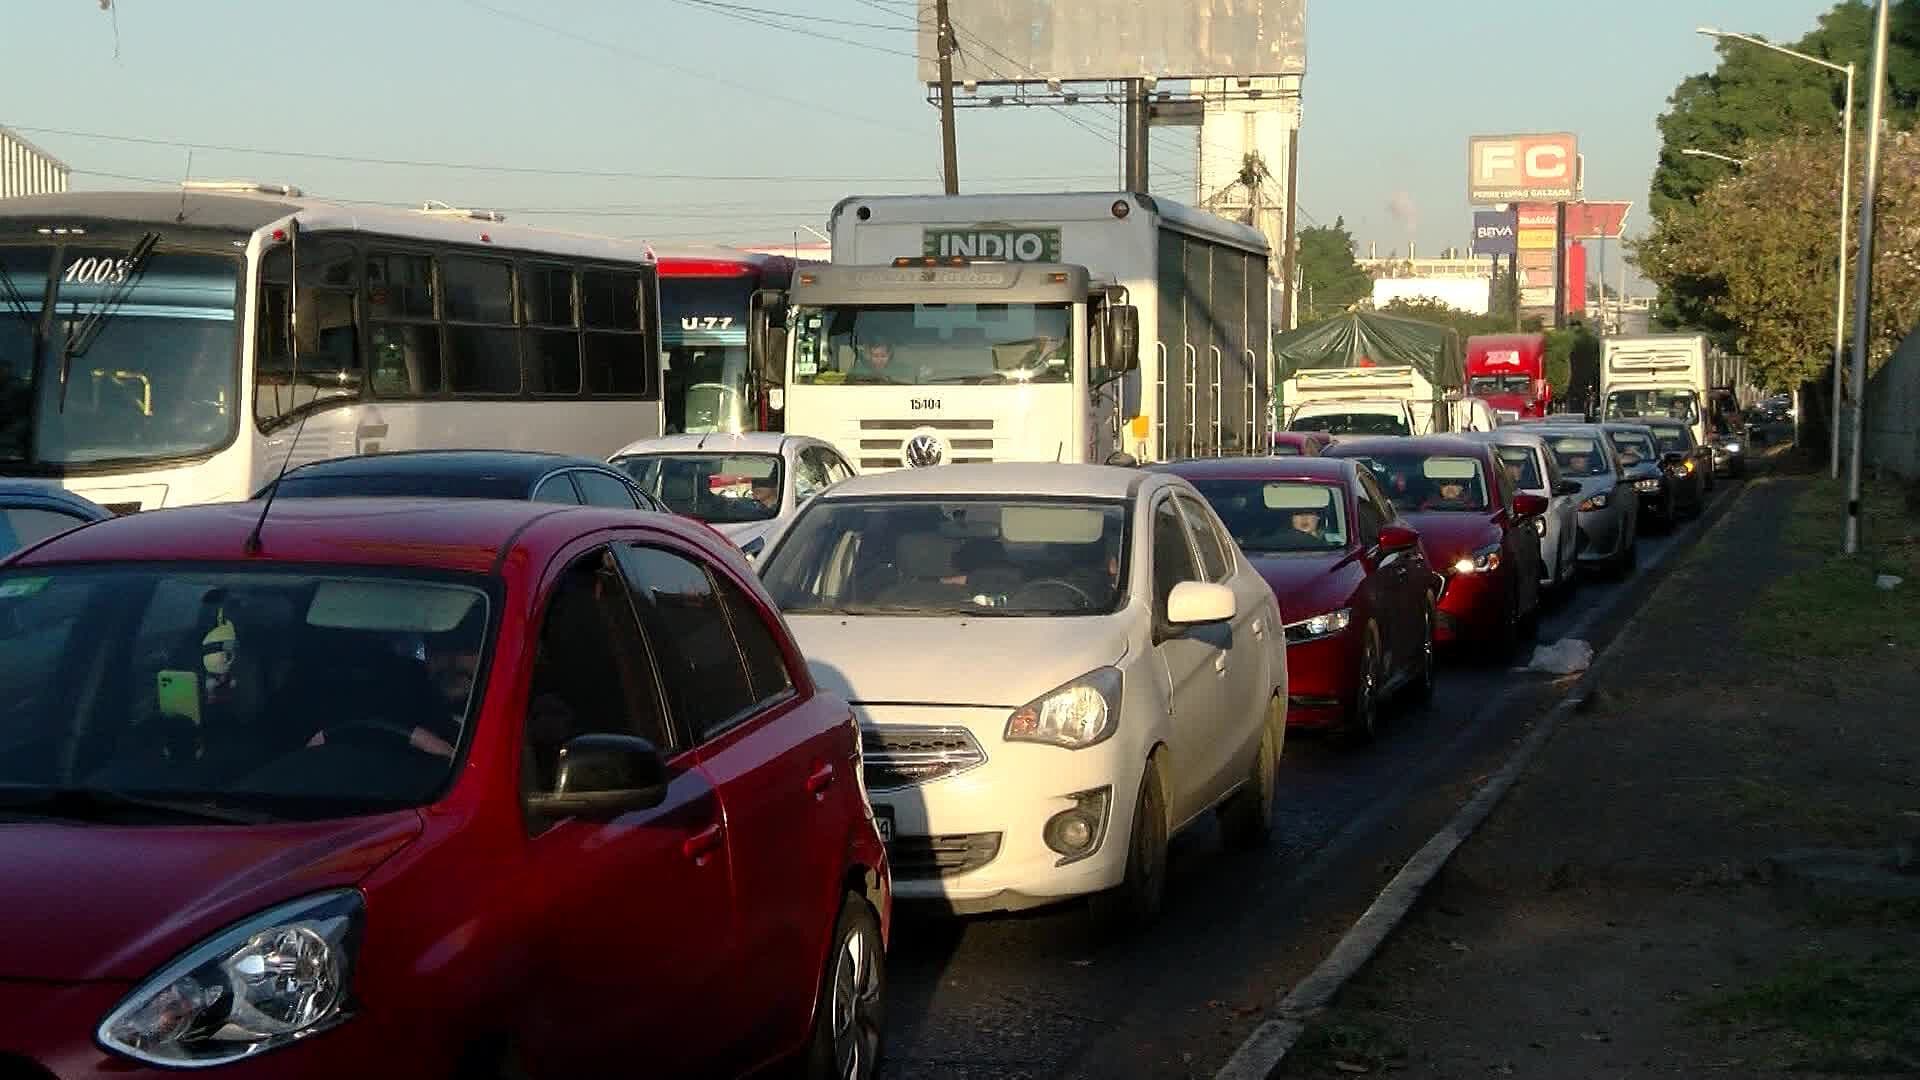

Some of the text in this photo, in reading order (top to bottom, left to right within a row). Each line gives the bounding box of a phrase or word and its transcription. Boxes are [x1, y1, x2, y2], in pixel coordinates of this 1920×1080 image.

[1477, 226, 1513, 238] BBVA
[940, 232, 1043, 261] INDIO
[681, 317, 733, 330] U-77
